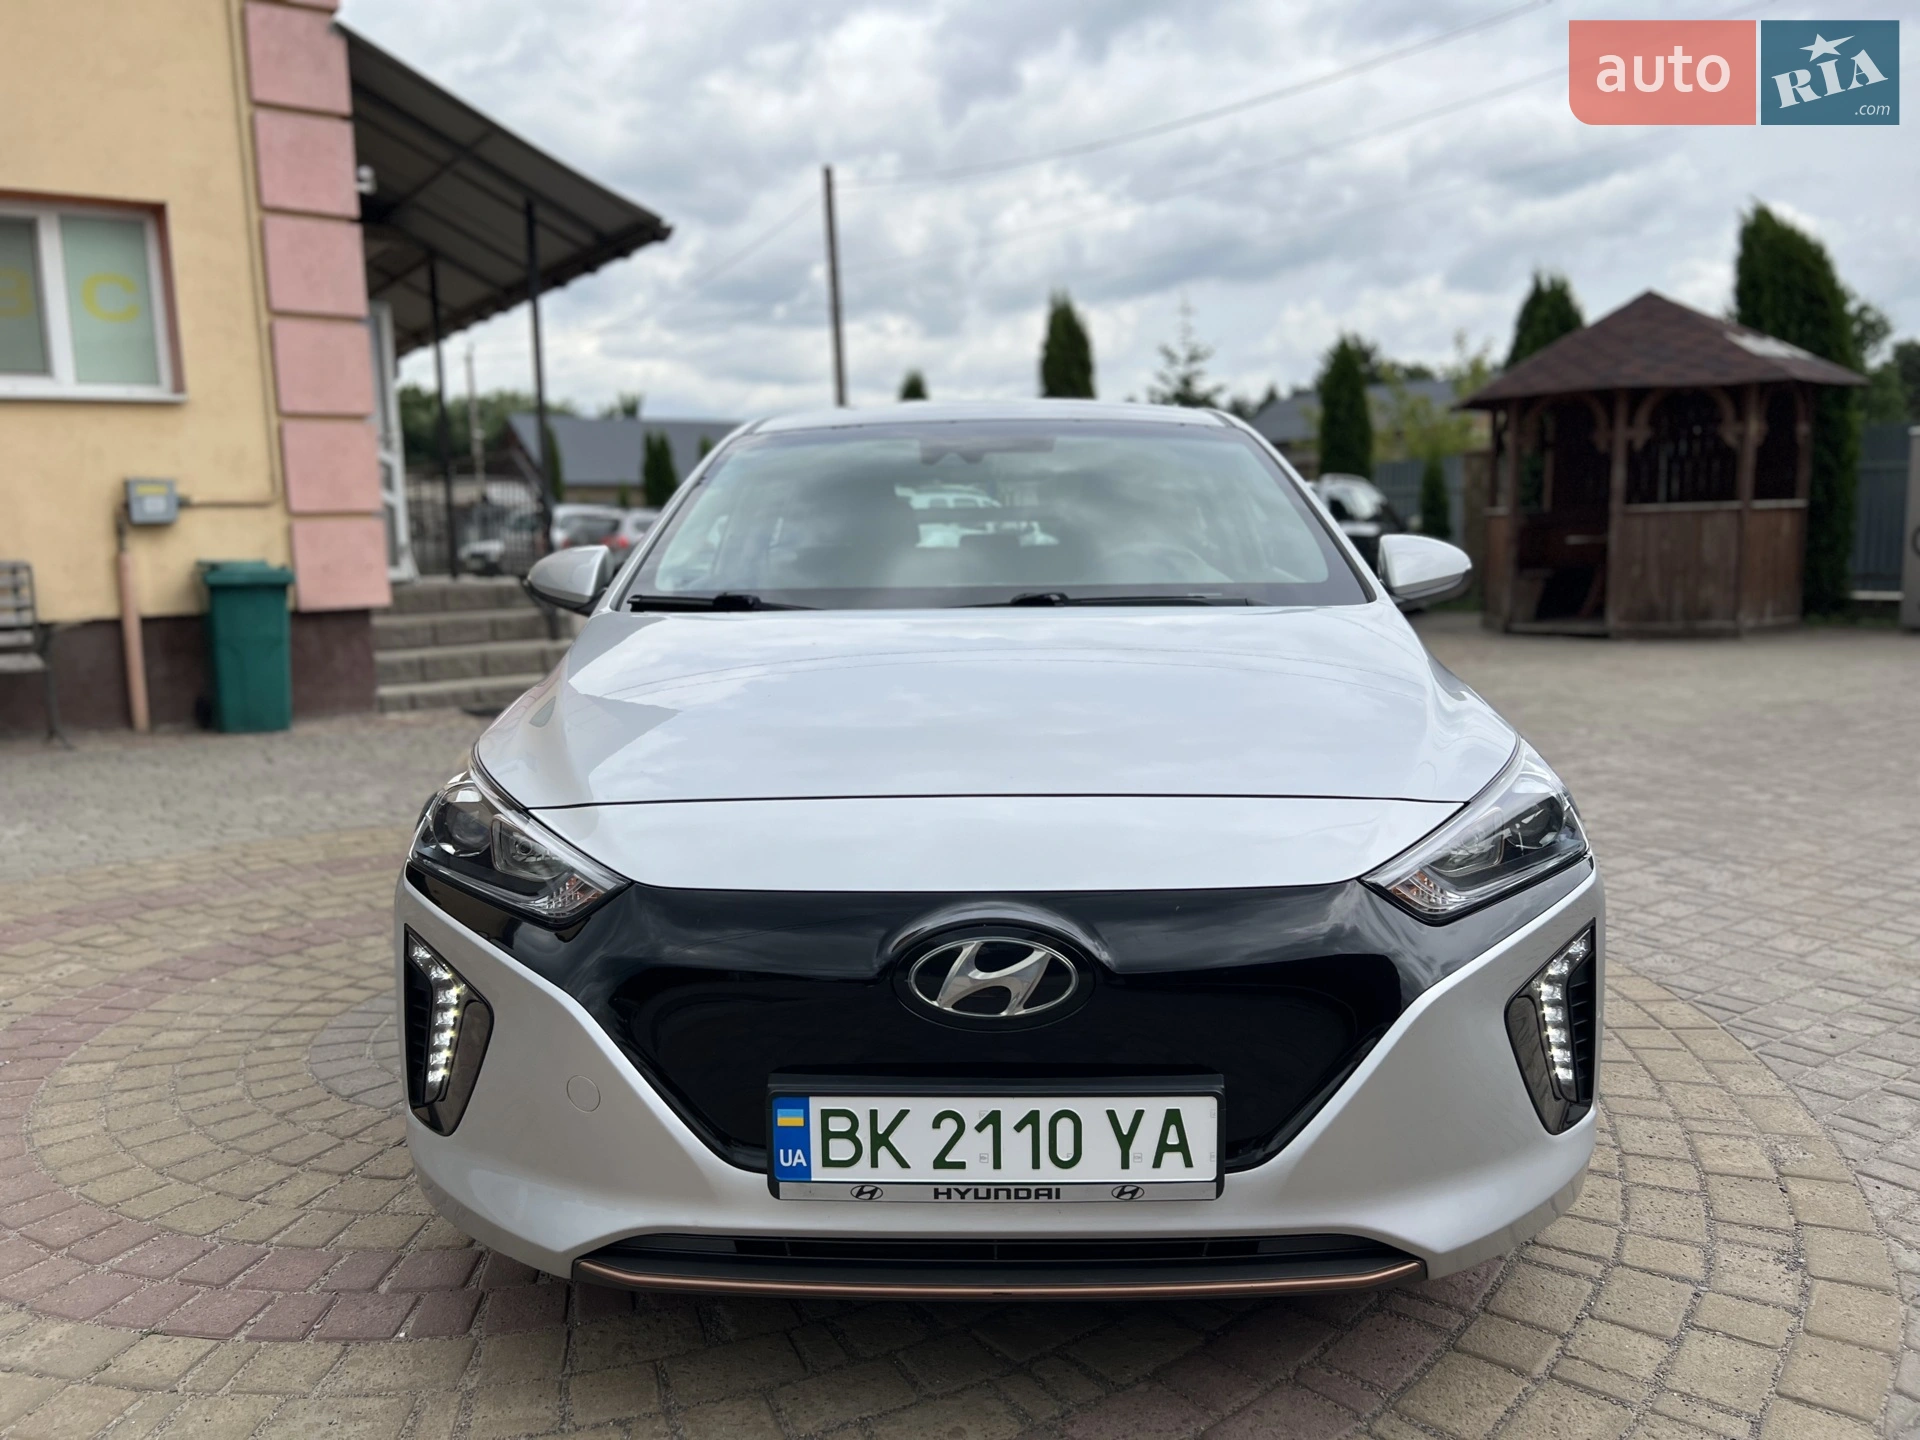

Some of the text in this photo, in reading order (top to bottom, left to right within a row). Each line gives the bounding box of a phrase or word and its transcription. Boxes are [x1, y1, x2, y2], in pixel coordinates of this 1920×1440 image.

[820, 1108, 1194, 1170] BK 2110 YA
[780, 1149, 807, 1167] UA
[933, 1187, 1061, 1200] HYUNDAI
